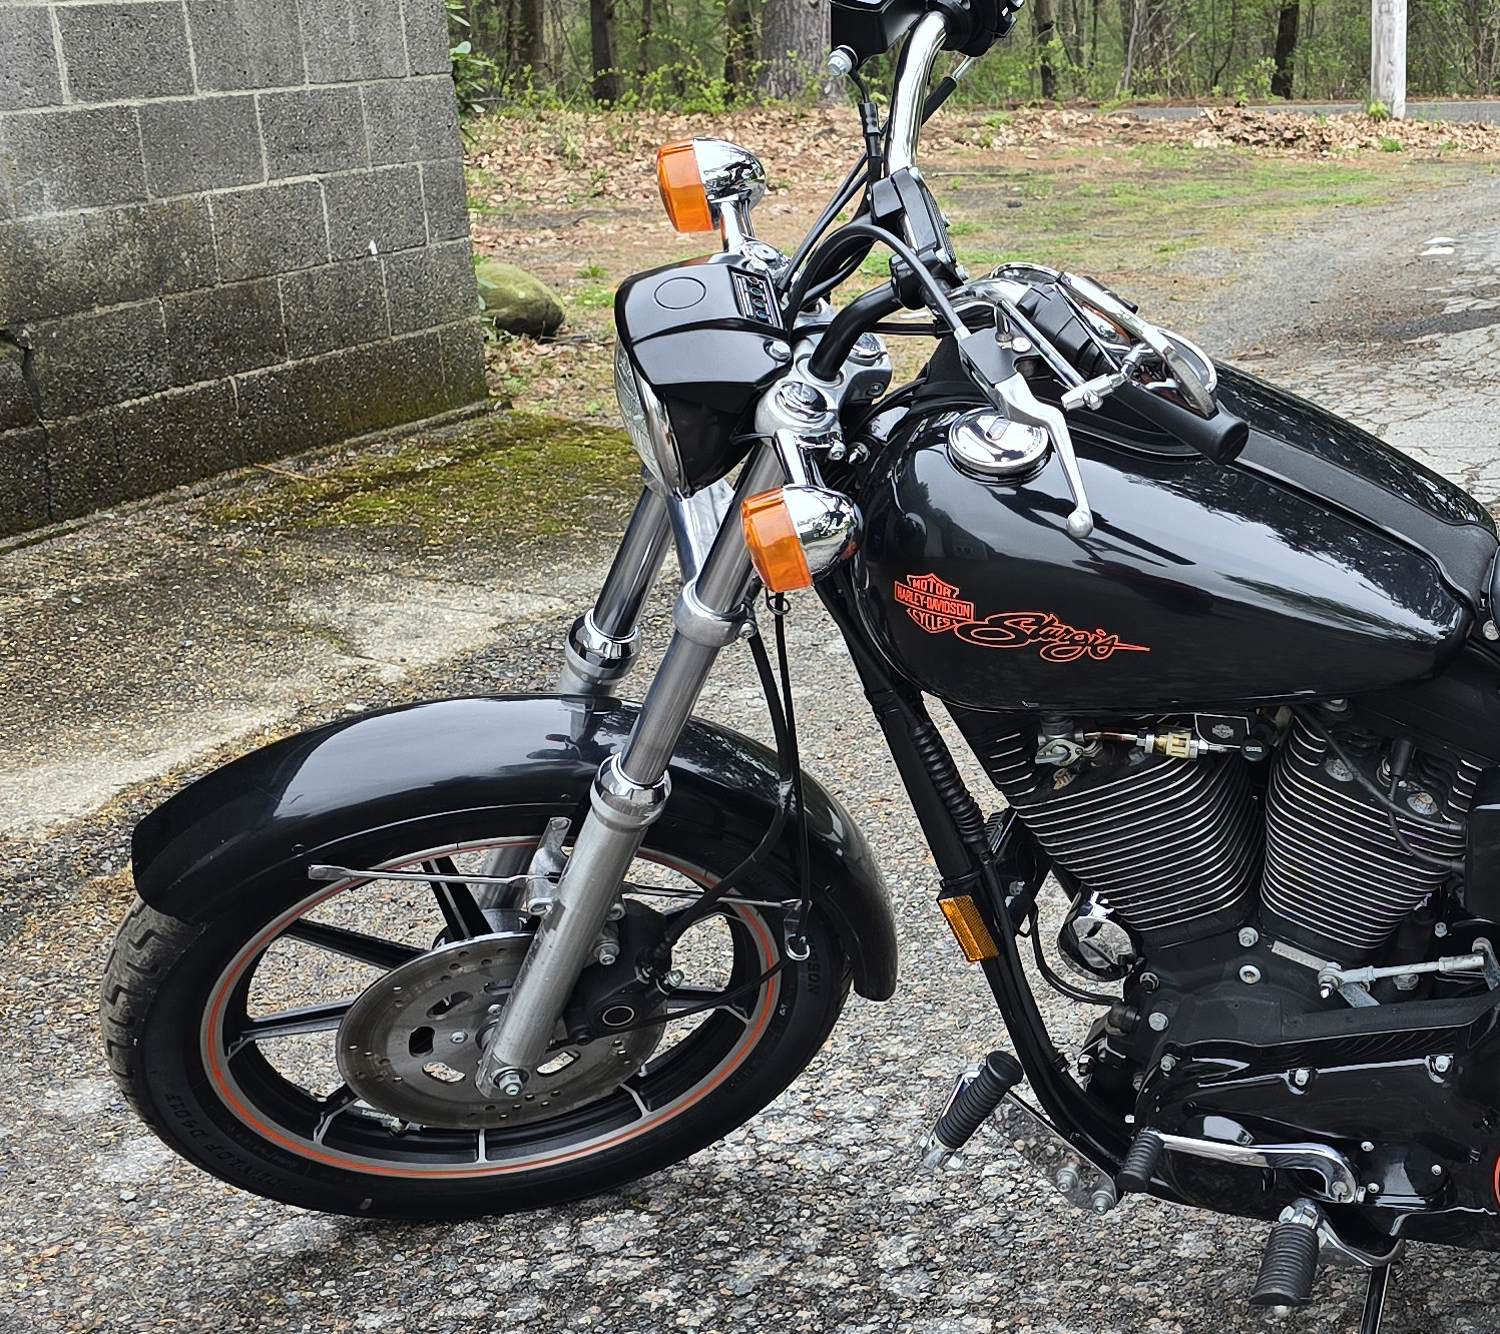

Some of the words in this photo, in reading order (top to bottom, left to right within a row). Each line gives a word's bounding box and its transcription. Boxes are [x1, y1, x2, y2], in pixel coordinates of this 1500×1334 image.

[897, 585, 971, 618] HARLEY-DAVIDSON
[912, 578, 952, 598] MOTOR
[912, 609, 951, 631] CYCLES
[953, 610, 1151, 663] Sturgis
